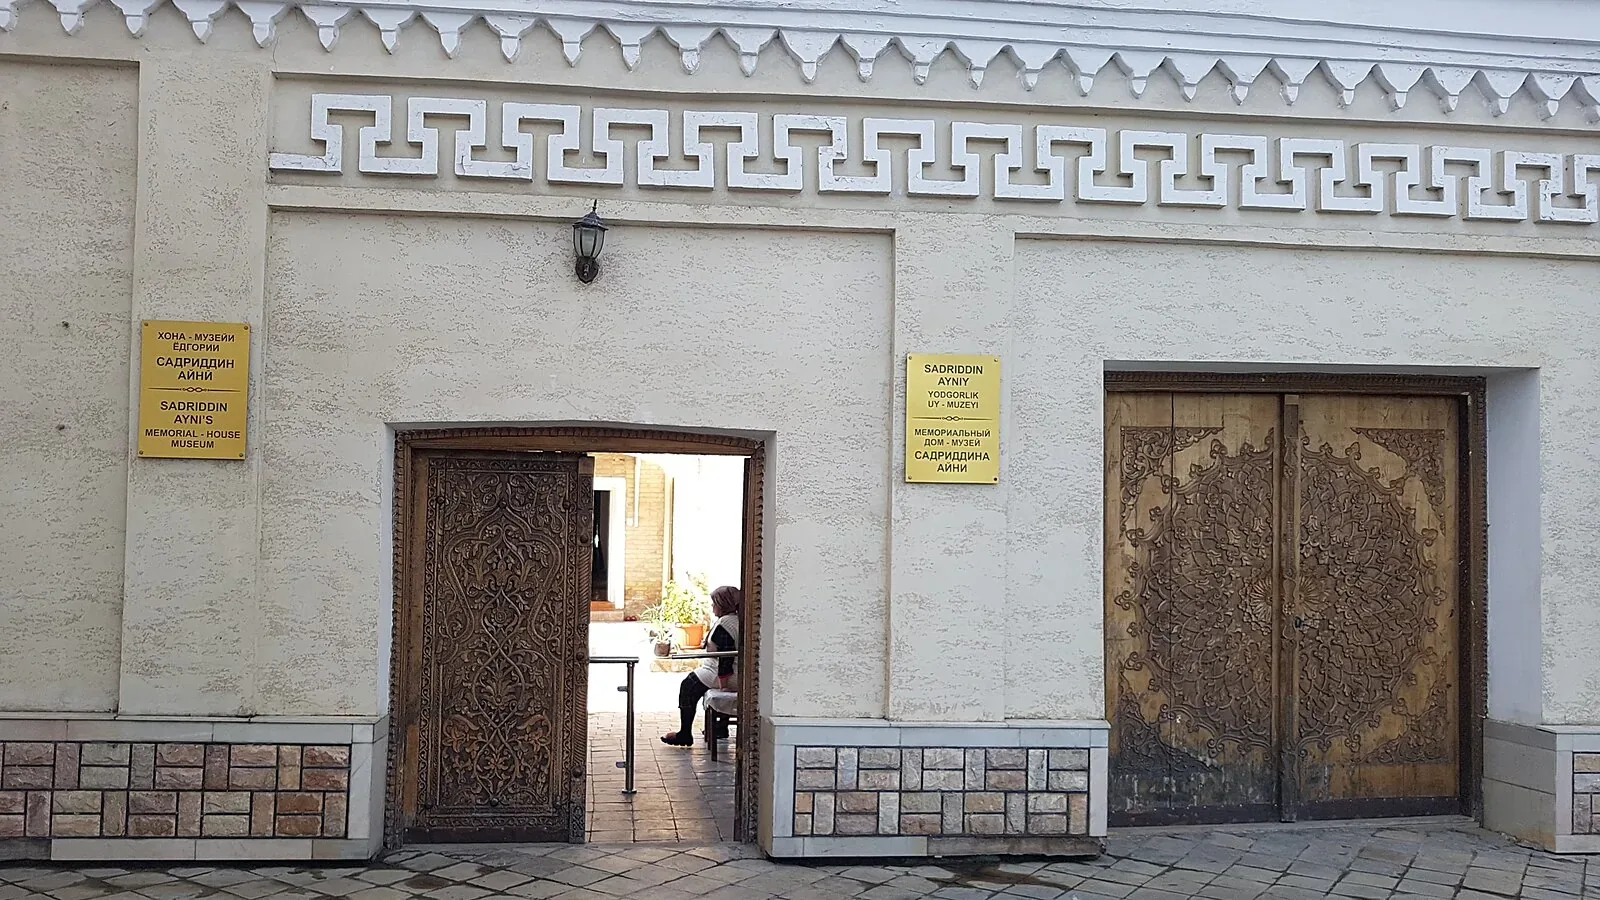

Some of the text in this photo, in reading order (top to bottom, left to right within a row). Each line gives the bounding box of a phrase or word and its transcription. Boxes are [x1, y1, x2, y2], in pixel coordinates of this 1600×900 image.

[157, 331, 186, 341] ХОНА
[194, 332, 235, 343] МУЗЕЙИ
[172, 342, 220, 352] ЁДГОРИИ
[156, 356, 235, 370] САДРИДДИН
[924, 364, 983, 375] SADRIDDIN
[937, 376, 970, 387] AYNIY
[927, 390, 979, 400] YODGORLIK
[160, 400, 228, 412] SADRIDDIN
[927, 400, 940, 408] UY
[946, 401, 979, 409] MUZEYI
[173, 414, 214, 425] AYNI'S
[144, 428, 199, 438] MEMORIAL
[206, 430, 241, 439] HOUSE
[914, 428, 991, 438] МЕМОРИАЛЬНЫЙ
[170, 439, 215, 449] MUSEUM
[923, 438, 944, 447] ДОМ
[951, 438, 981, 447] МУЗЕЙ
[914, 450, 990, 462] САДРИДДИНА
[936, 461, 968, 473] АЙНИ
